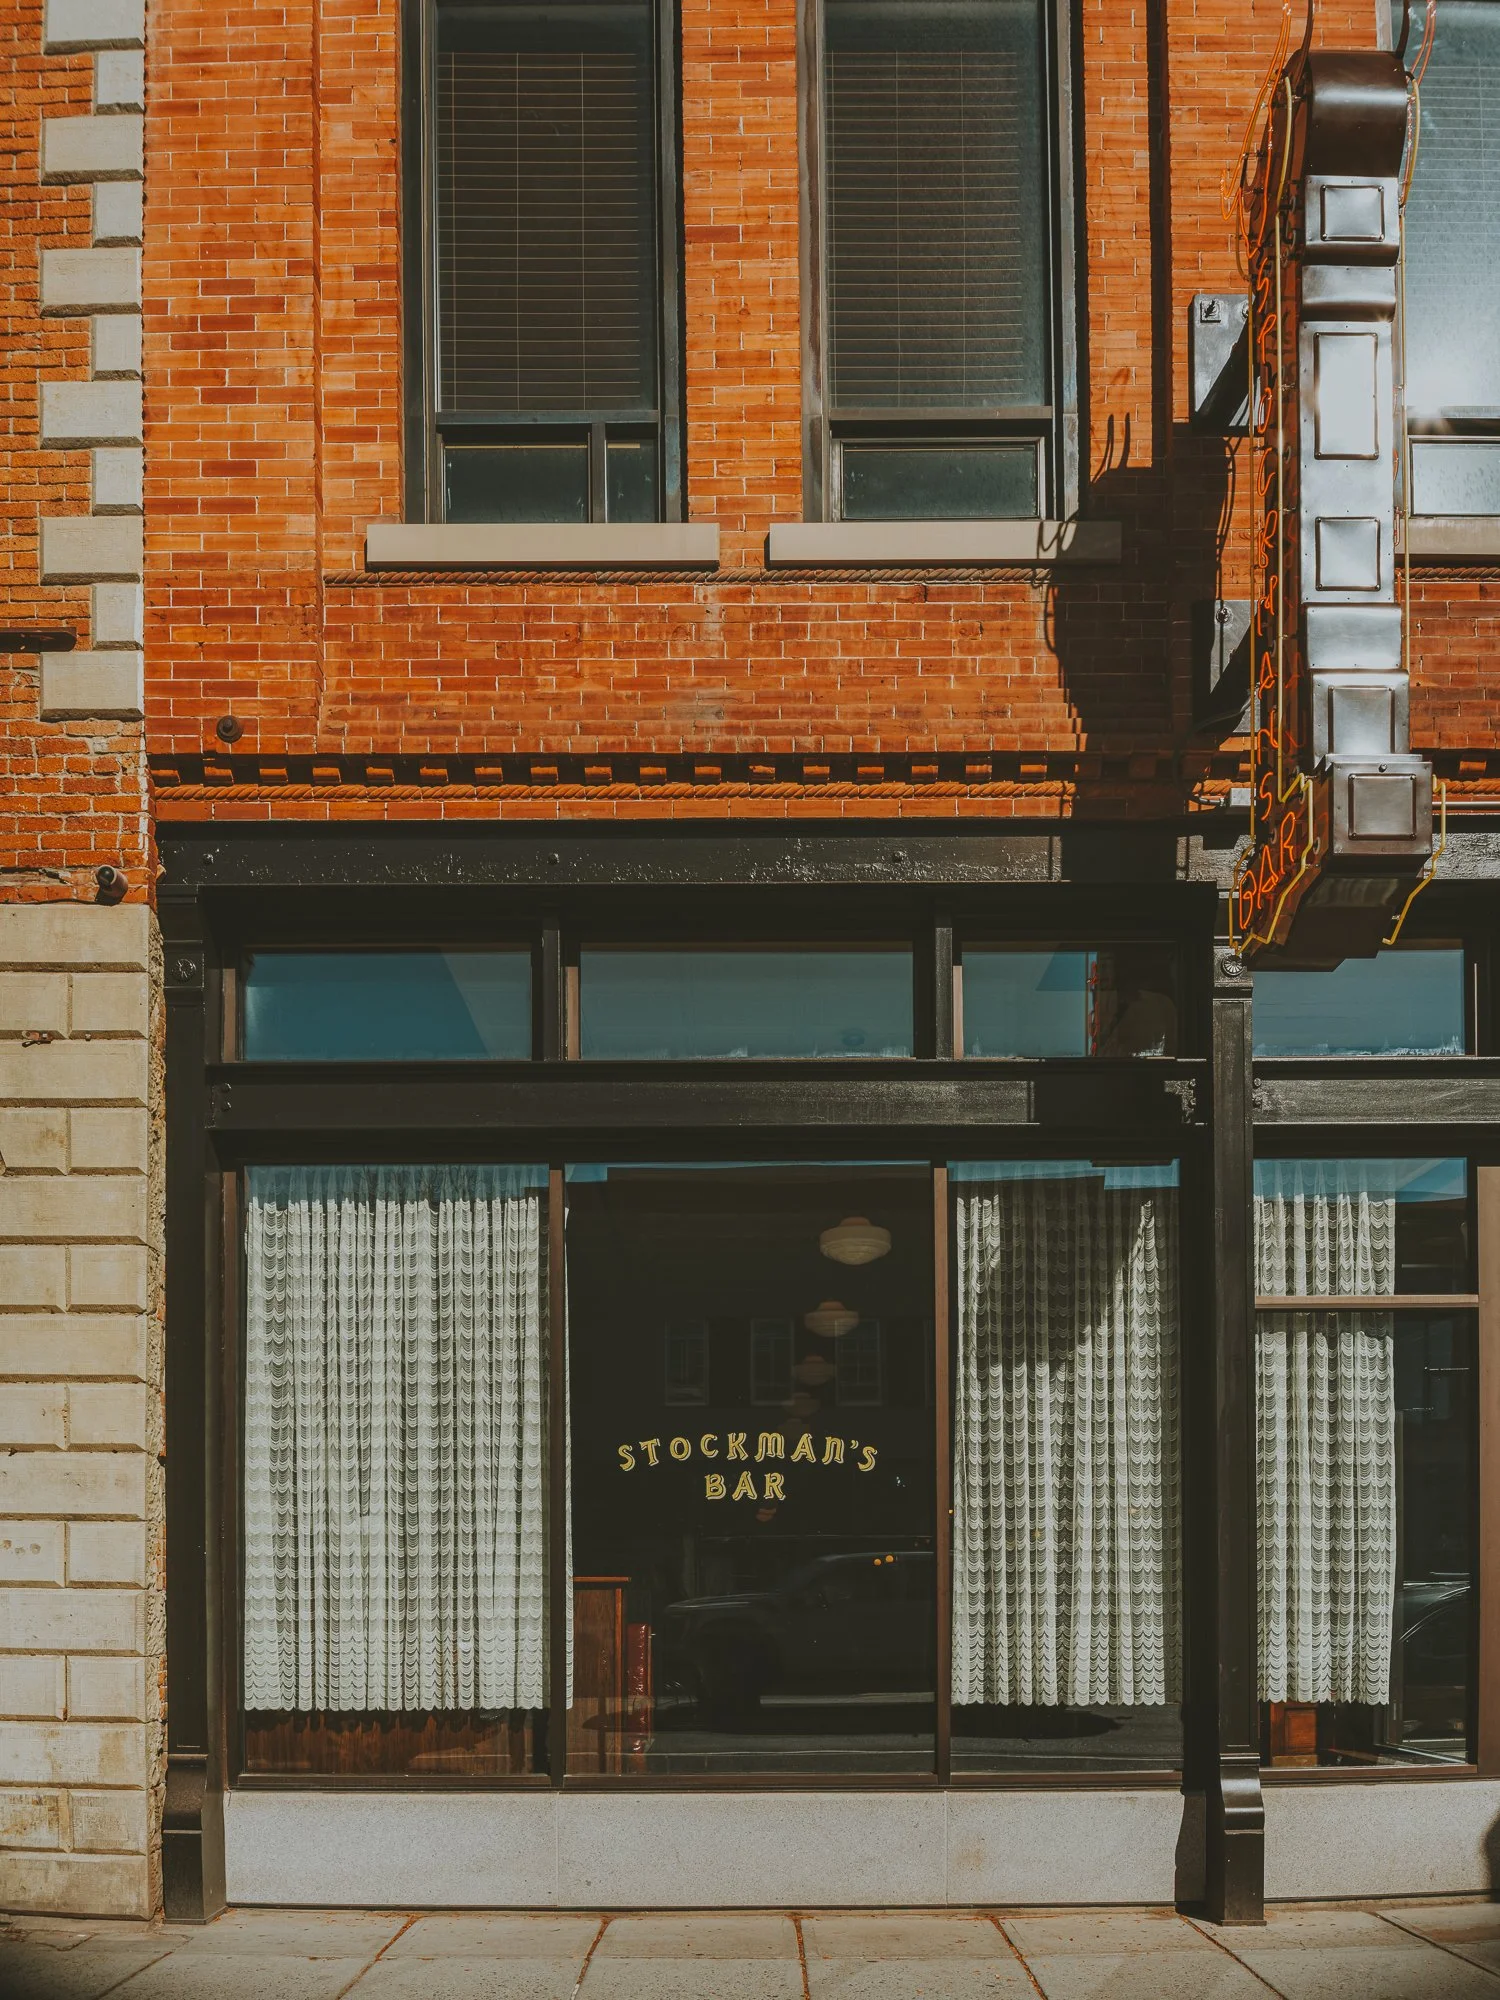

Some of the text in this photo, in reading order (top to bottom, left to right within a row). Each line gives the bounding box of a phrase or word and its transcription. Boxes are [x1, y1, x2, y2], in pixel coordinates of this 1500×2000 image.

[1239, 811, 1296, 929] BAR
[617, 1432, 878, 1471] STOCKMAN'S
[704, 1471, 786, 1500] BAR
